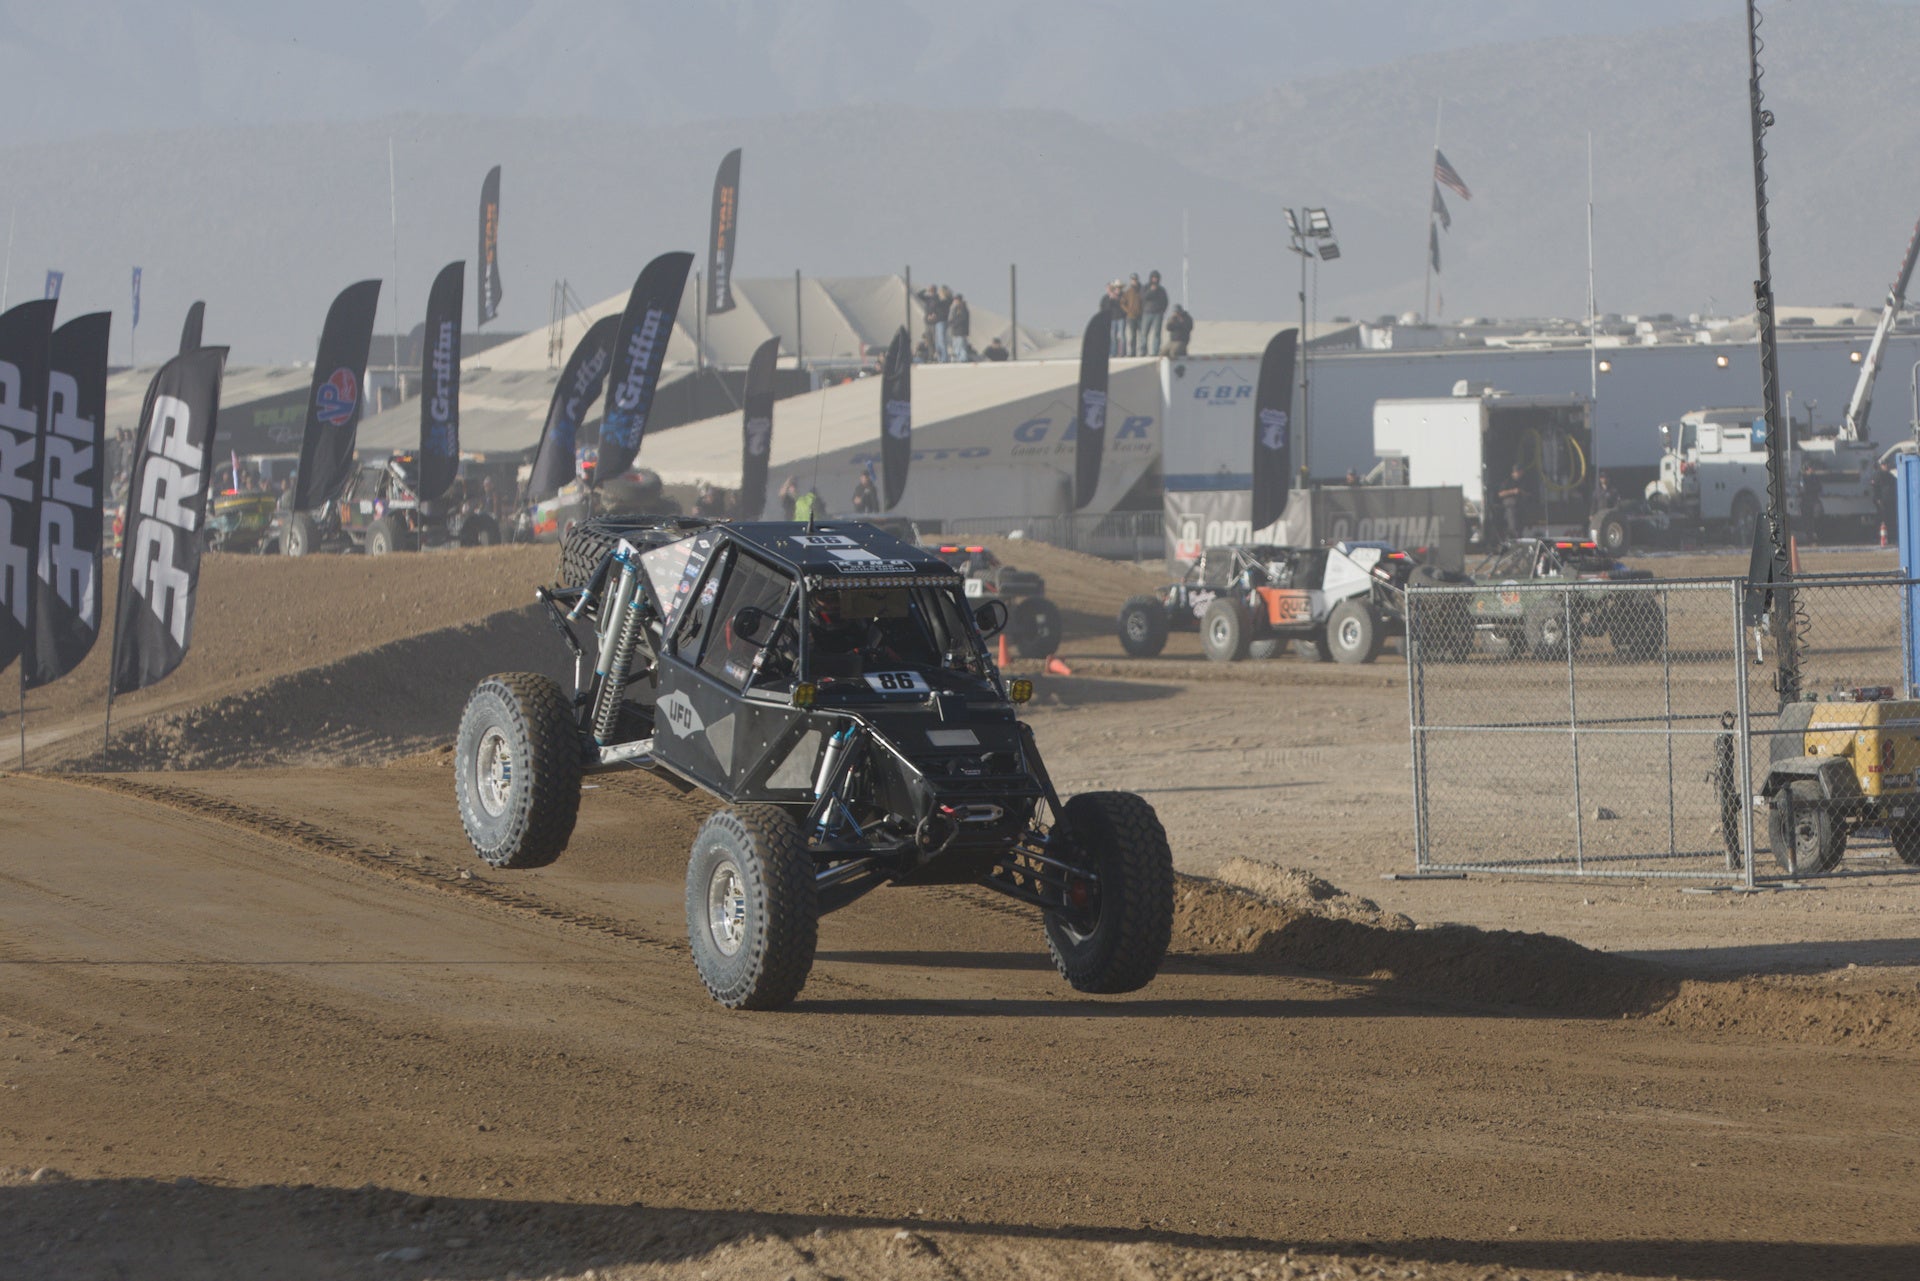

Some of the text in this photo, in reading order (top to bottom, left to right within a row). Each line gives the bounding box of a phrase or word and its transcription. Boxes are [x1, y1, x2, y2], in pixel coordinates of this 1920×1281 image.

[430, 321, 452, 422] Griffin
[614, 308, 663, 410] Griffin
[316, 382, 353, 422] VP
[1194, 385, 1253, 398] GBR
[37, 369, 95, 632] PRP
[132, 394, 203, 649] PRP
[1357, 517, 1441, 548] OPTIMA
[878, 672, 915, 690] 86
[669, 699, 692, 730] UFO
